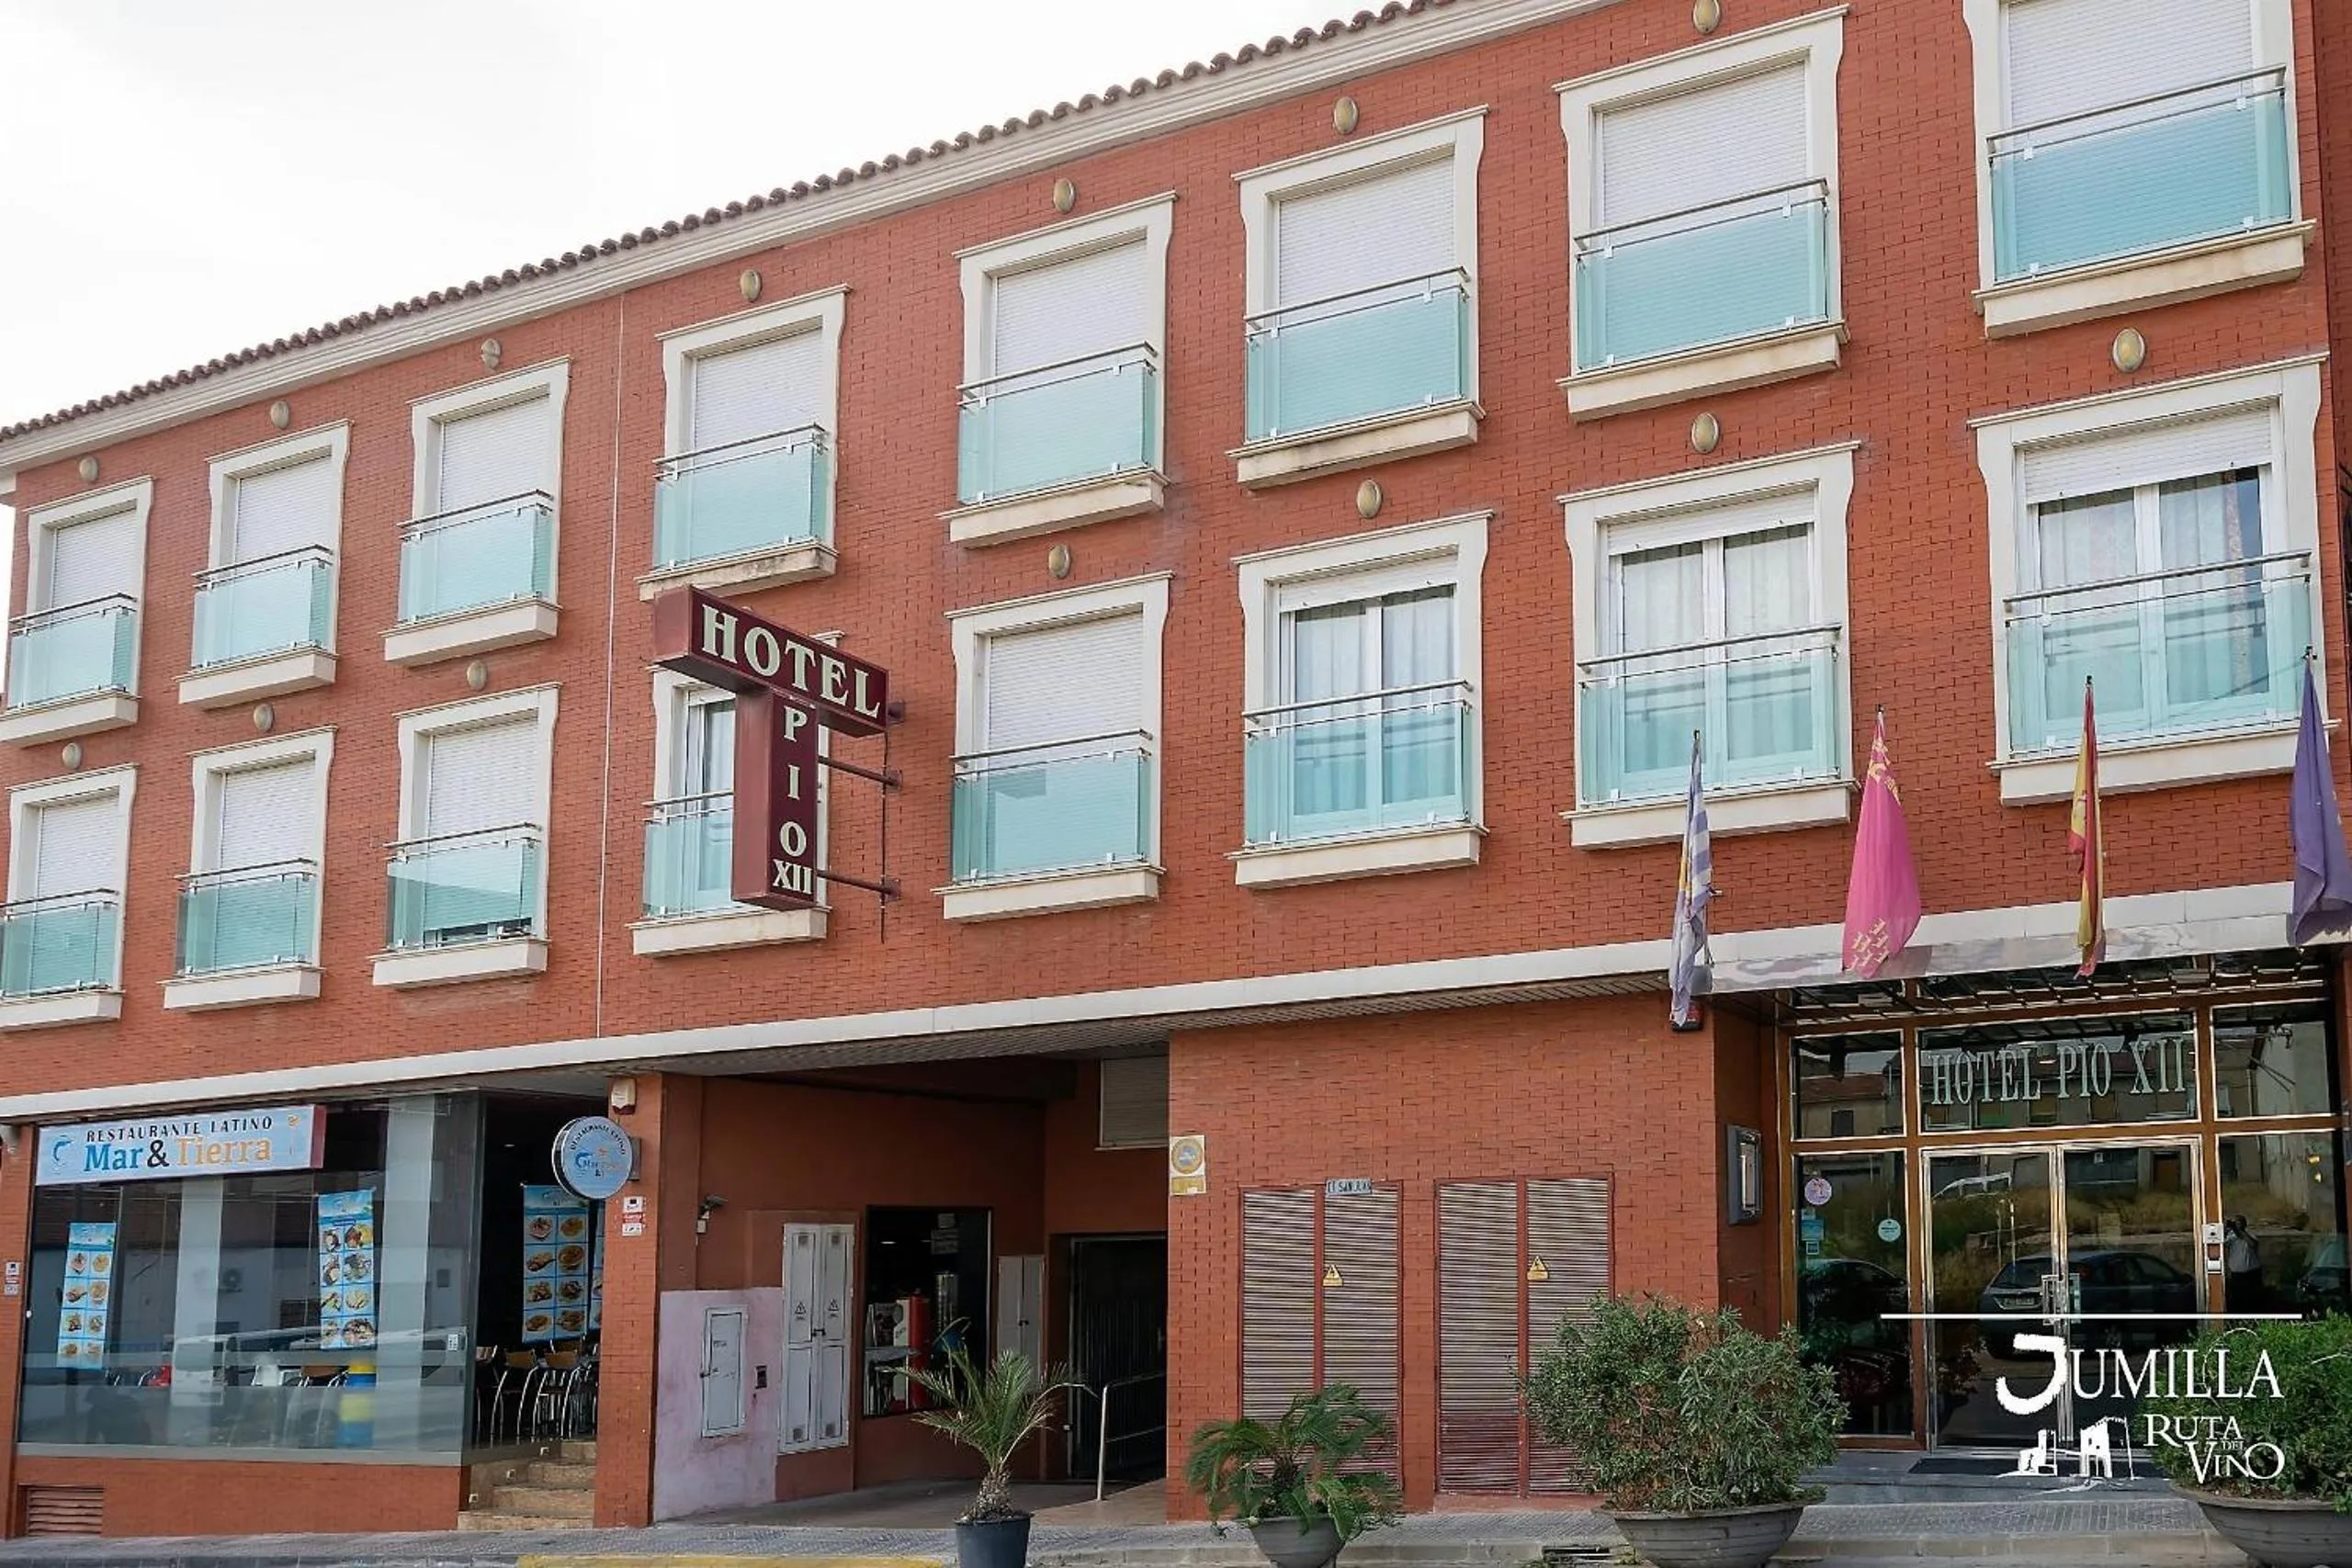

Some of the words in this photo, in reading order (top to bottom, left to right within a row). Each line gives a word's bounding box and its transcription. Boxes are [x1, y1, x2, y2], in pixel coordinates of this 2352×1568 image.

[701, 604, 880, 718] HOTEL
[780, 705, 808, 857] PIO
[772, 859, 813, 895] XII
[1930, 1049, 2041, 1105] HOTEL
[2058, 1042, 2111, 1097] PIO
[2129, 1038, 2186, 1094] XII
[84, 1143, 143, 1172] Mar
[147, 1139, 170, 1168] &
[176, 1136, 272, 1167] Tierra
[86, 1122, 200, 1142] RESTAURANTE
[210, 1116, 273, 1132] LATINO
